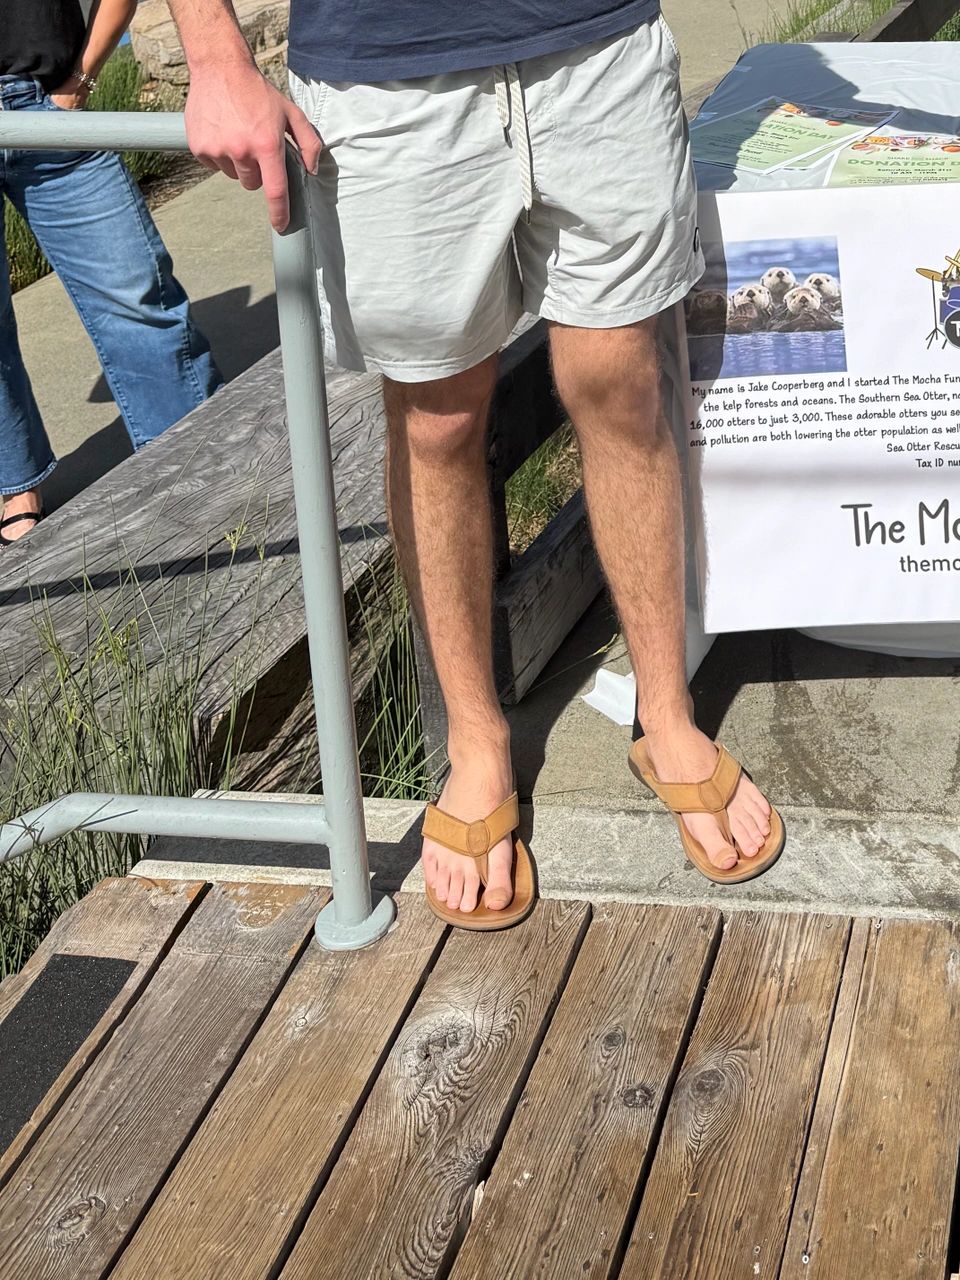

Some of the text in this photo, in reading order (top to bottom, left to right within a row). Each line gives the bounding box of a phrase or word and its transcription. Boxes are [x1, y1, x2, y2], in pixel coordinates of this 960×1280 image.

[808, 131, 837, 141] DAY
[847, 159, 945, 167] DONATION
[691, 386, 707, 399] My
[708, 387, 734, 396] name
[737, 384, 746, 394] is
[747, 382, 769, 393] Jake
[771, 379, 825, 393] Cooperberg
[826, 377, 845, 388] and
[854, 376, 890, 387] started
[892, 374, 910, 385] The
[912, 374, 941, 385] Mocha
[703, 402, 720, 412] the
[723, 400, 742, 412] kelp
[745, 398, 779, 409] forests
[781, 396, 799, 407] and
[802, 397, 837, 407] oceans.
[839, 394, 856, 404] The
[858, 392, 901, 403] Southern
[903, 392, 921, 402] Sea
[922, 391, 951, 402] Otter,
[690, 419, 724, 430] 16,000
[727, 417, 755, 426] otters
[757, 416, 767, 425] to
[769, 414, 789, 427] just
[792, 412, 823, 424] 3,000.
[825, 411, 853, 421] These
[856, 409, 896, 420] adorable
[899, 408, 928, 418] otters
[931, 409, 947, 420] you
[690, 437, 707, 448] and
[710, 433, 750, 448] pollution
[752, 434, 768, 442] are
[770, 430, 792, 442] both
[795, 429, 833, 442] lowering
[836, 428, 851, 438] the
[854, 428, 877, 437] otter
[881, 425, 929, 438] population
[931, 426, 943, 434] as
[886, 443, 905, 453] Sea
[907, 442, 932, 452] Otter
[915, 458, 932, 468] Tax
[935, 458, 944, 468] ID
[840, 503, 905, 547] The
